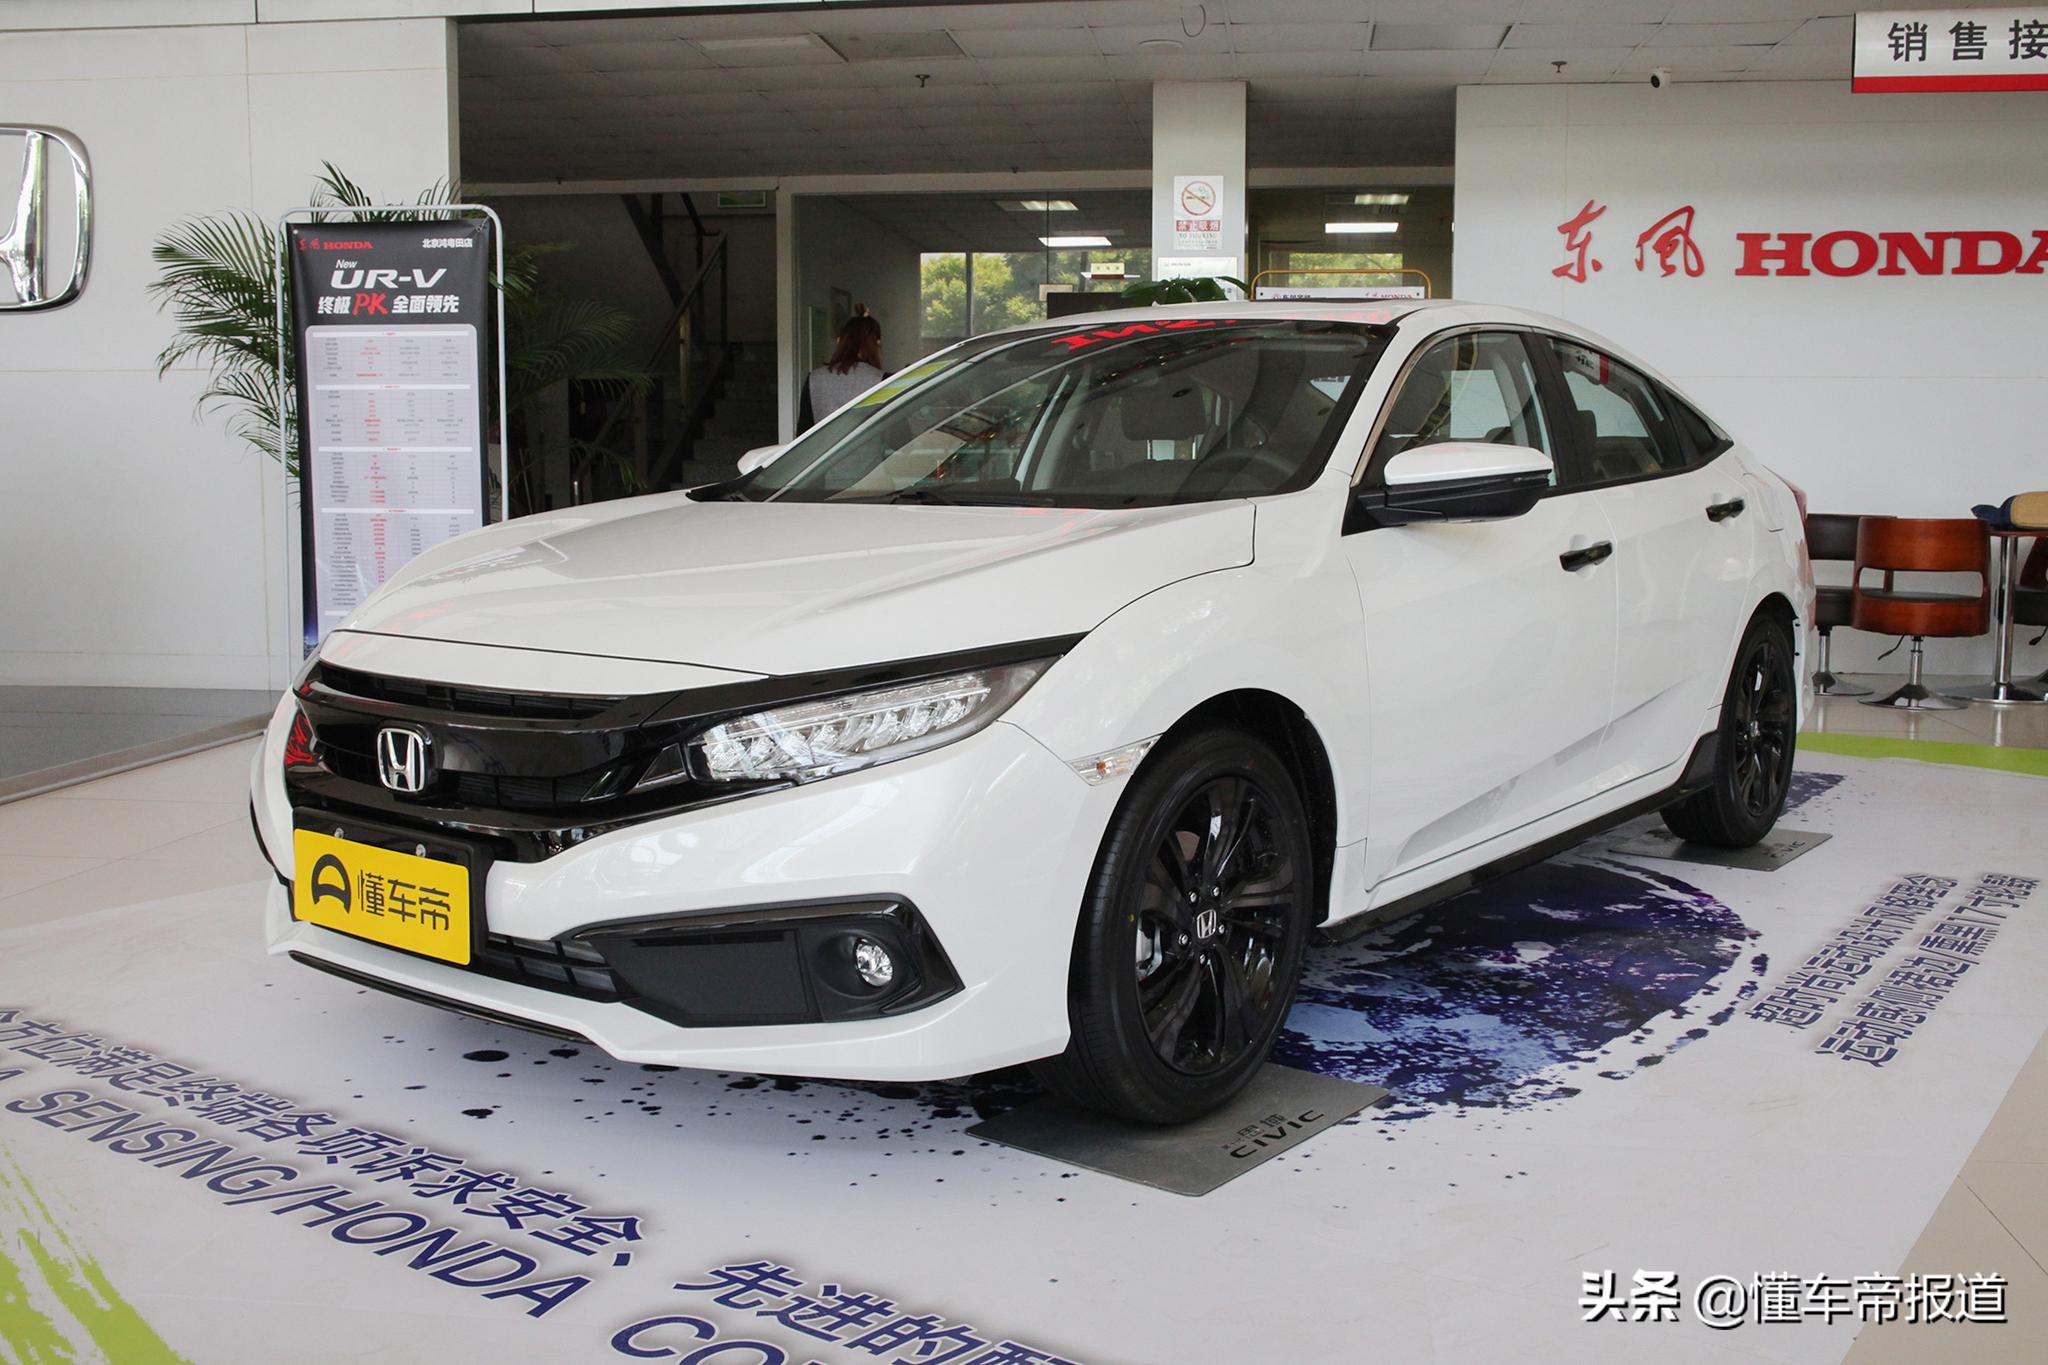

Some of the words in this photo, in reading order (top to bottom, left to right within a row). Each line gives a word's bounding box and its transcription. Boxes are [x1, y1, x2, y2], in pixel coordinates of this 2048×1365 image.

[1888, 19, 2048, 62] 销售接
[323, 241, 374, 249] HONDA
[336, 259, 357, 269] New
[331, 268, 447, 289] UR-V
[357, 869, 451, 931] 懂车帝
[0, 1010, 642, 1267] 方位满足终端各项诉求安全、
[1230, 1110, 1325, 1158] CIVIC
[673, 1262, 1085, 1365] 先进的
